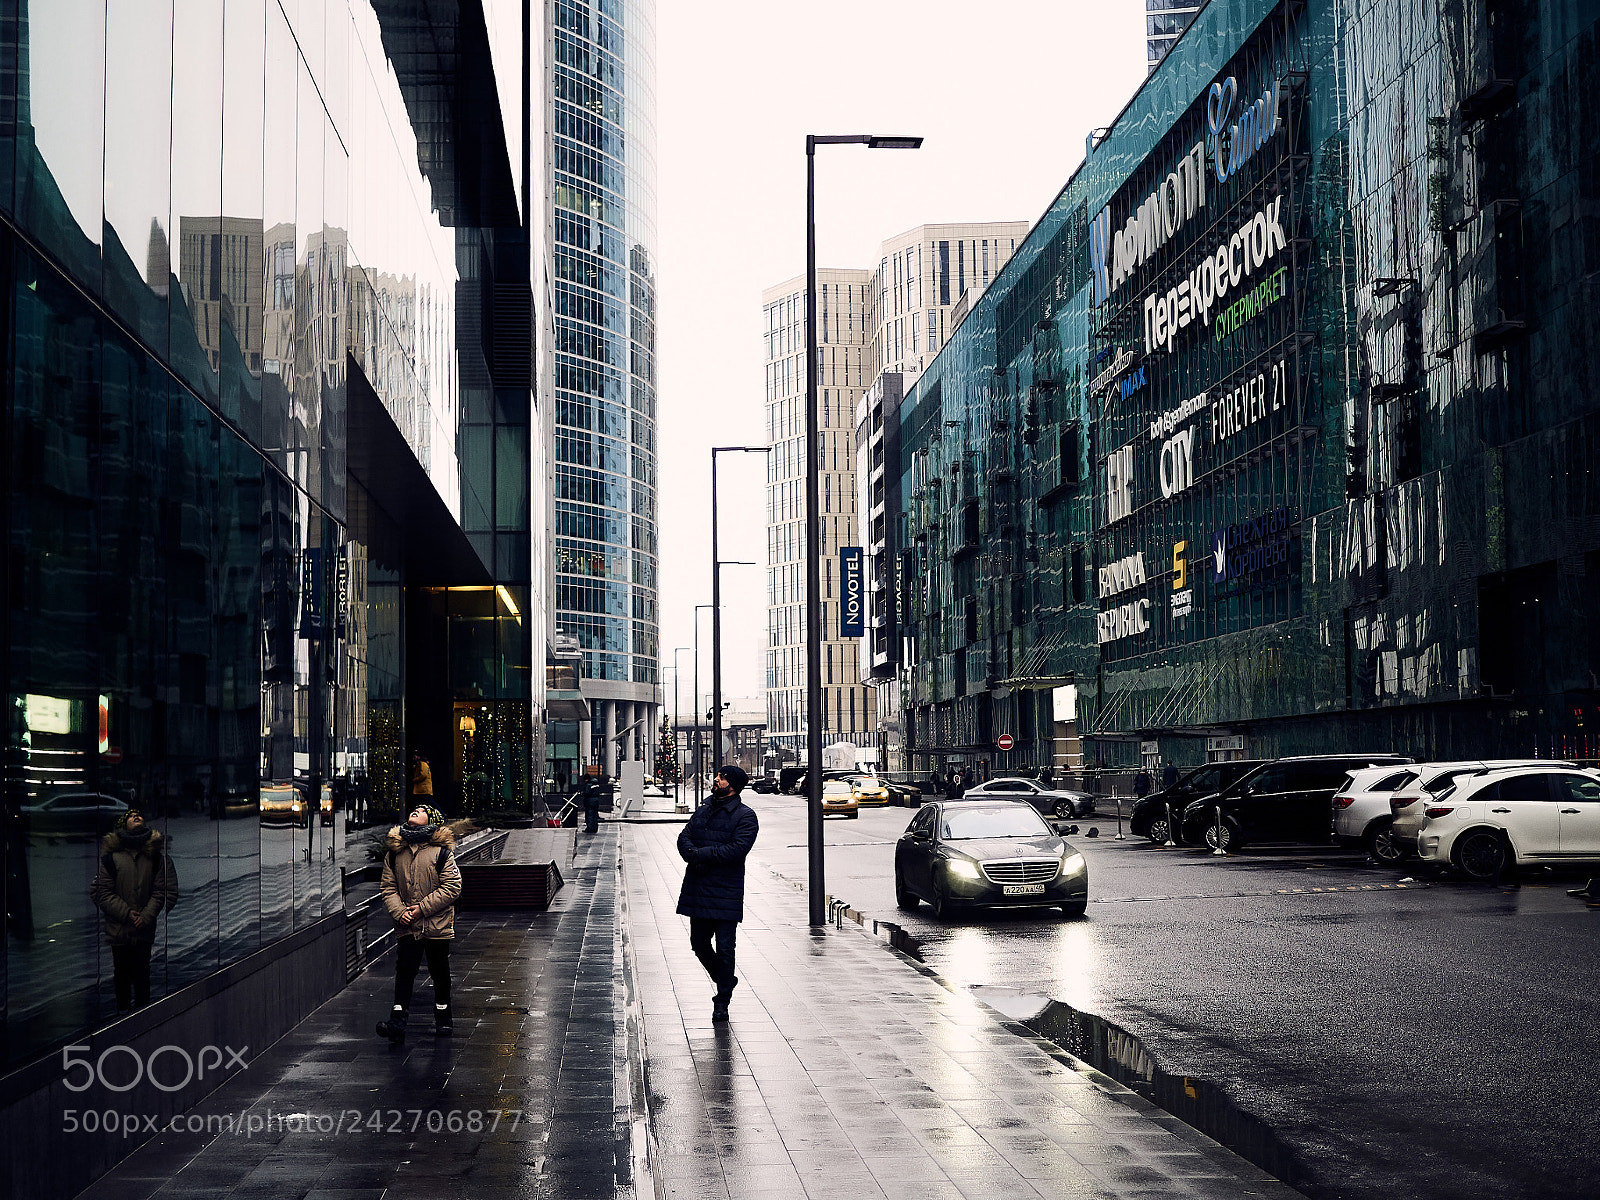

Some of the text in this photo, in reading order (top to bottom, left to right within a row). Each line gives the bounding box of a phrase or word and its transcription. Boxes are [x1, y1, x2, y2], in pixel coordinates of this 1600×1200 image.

[1112, 141, 1206, 293] АФИМОЛЛ
[1215, 266, 1288, 342] СУПЕРМАРКЕТ
[1121, 365, 1148, 402] IMAX
[1212, 359, 1286, 445] FOREVER 21
[1160, 424, 1196, 499] CITY
[1226, 506, 1289, 550] Снежная
[845, 551, 859, 625] NOVOTEL
[1098, 551, 1146, 599] BANANA
[1226, 539, 1290, 581] Королева
[1097, 598, 1150, 644] REPUBLIC
